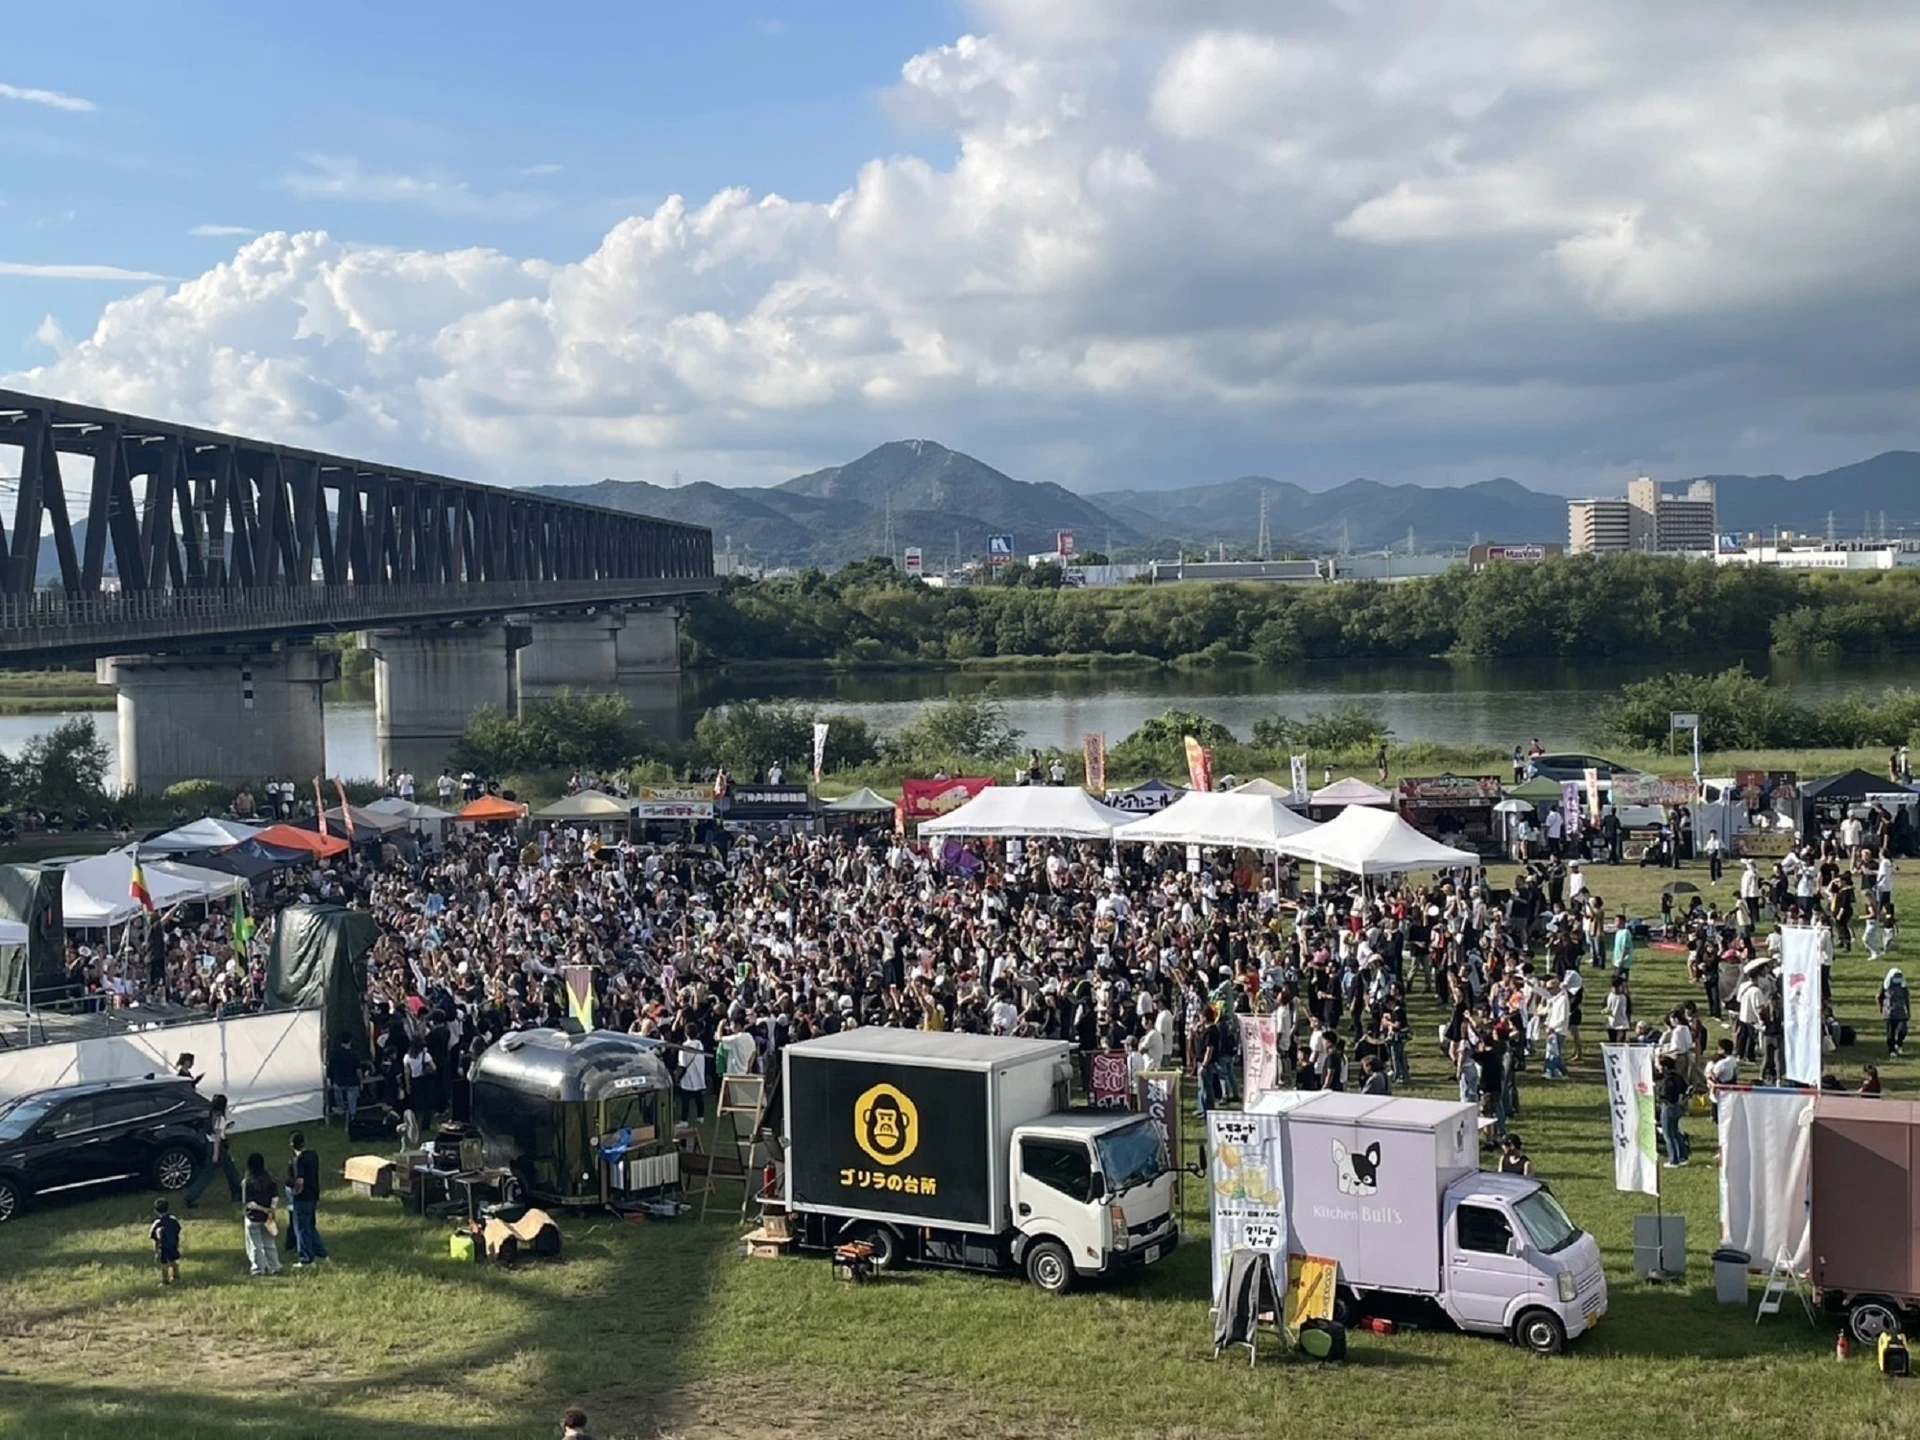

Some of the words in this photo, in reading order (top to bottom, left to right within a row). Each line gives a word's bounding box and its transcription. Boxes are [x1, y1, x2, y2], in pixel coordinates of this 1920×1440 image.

[1505, 546, 1541, 559] MaxValu
[1216, 1122, 1257, 1134] レモネード
[1225, 1134, 1249, 1144] ソーダ
[840, 1168, 937, 1195] ゴリラの台所
[1313, 1204, 1358, 1221] Kitchen
[1361, 1206, 1403, 1224] Bull's
[1246, 1226, 1278, 1236] クリーム
[1248, 1237, 1274, 1247] ソーダ
